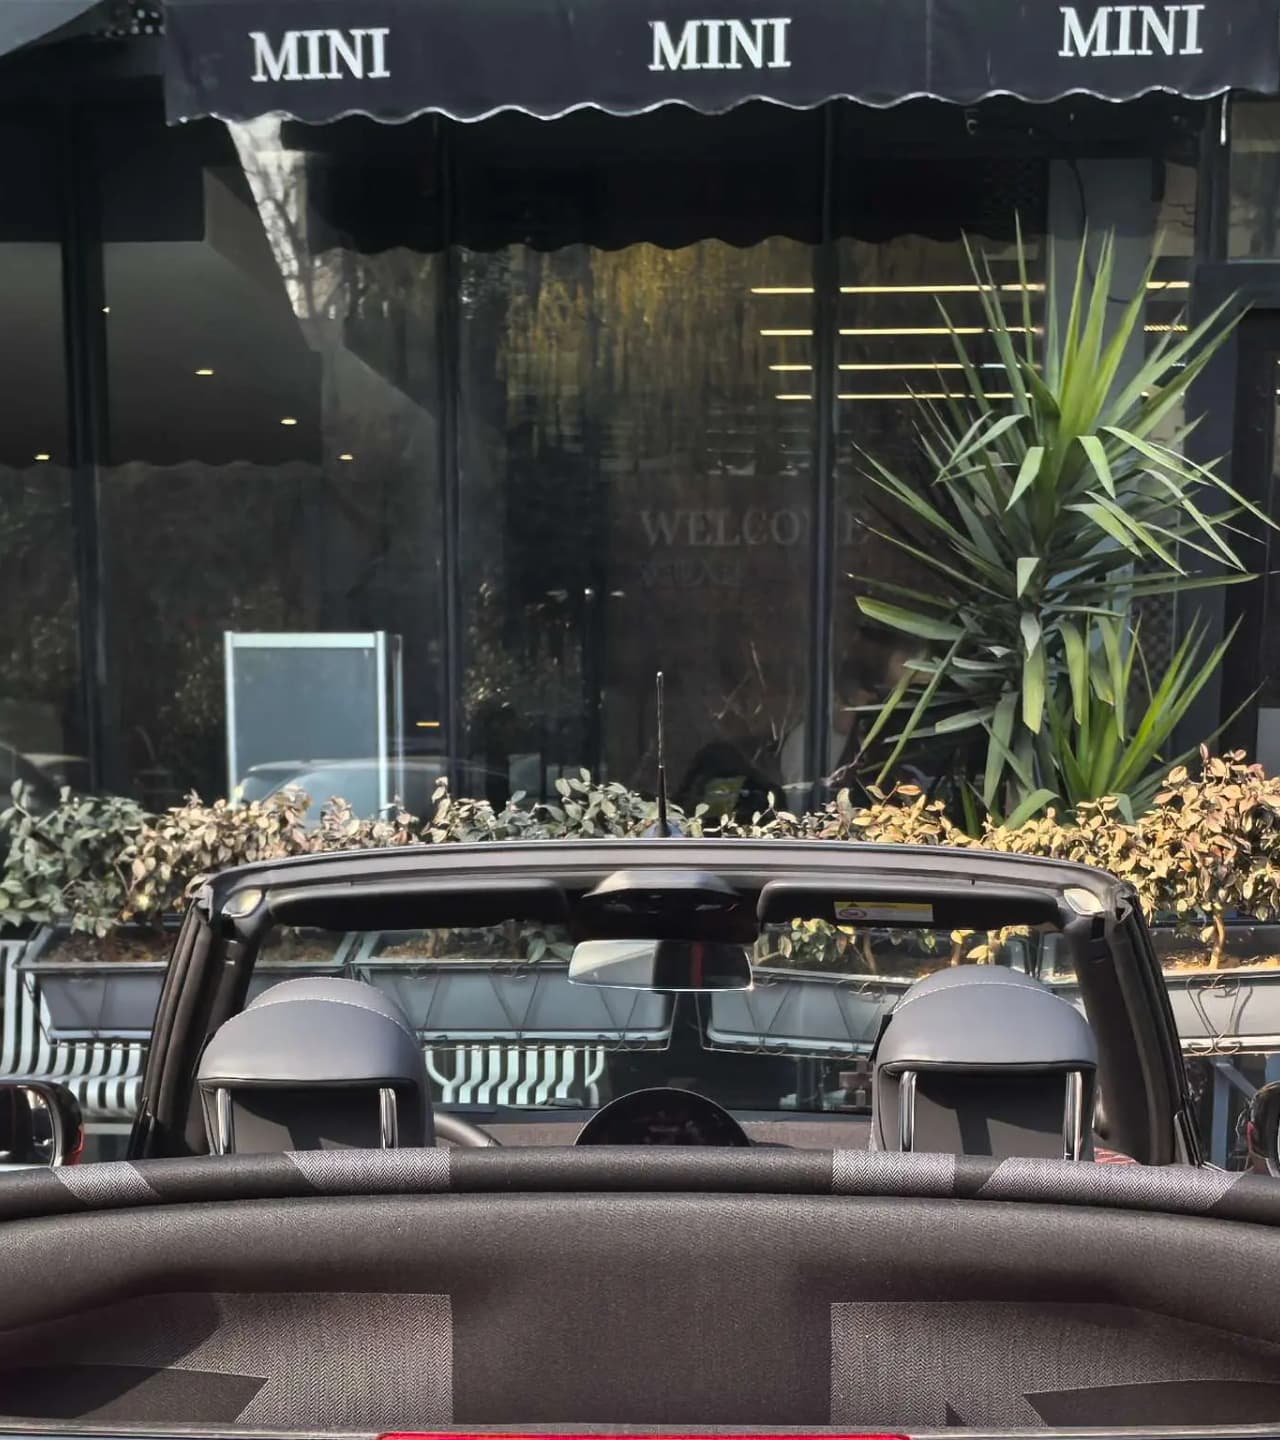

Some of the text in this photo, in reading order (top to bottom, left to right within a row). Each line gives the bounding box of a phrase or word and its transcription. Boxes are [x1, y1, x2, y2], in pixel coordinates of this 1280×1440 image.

[249, 27, 391, 82] MINI
[648, 17, 792, 71] MINI
[1058, 4, 1206, 57] MINI
[640, 508, 870, 547] WELCOE
